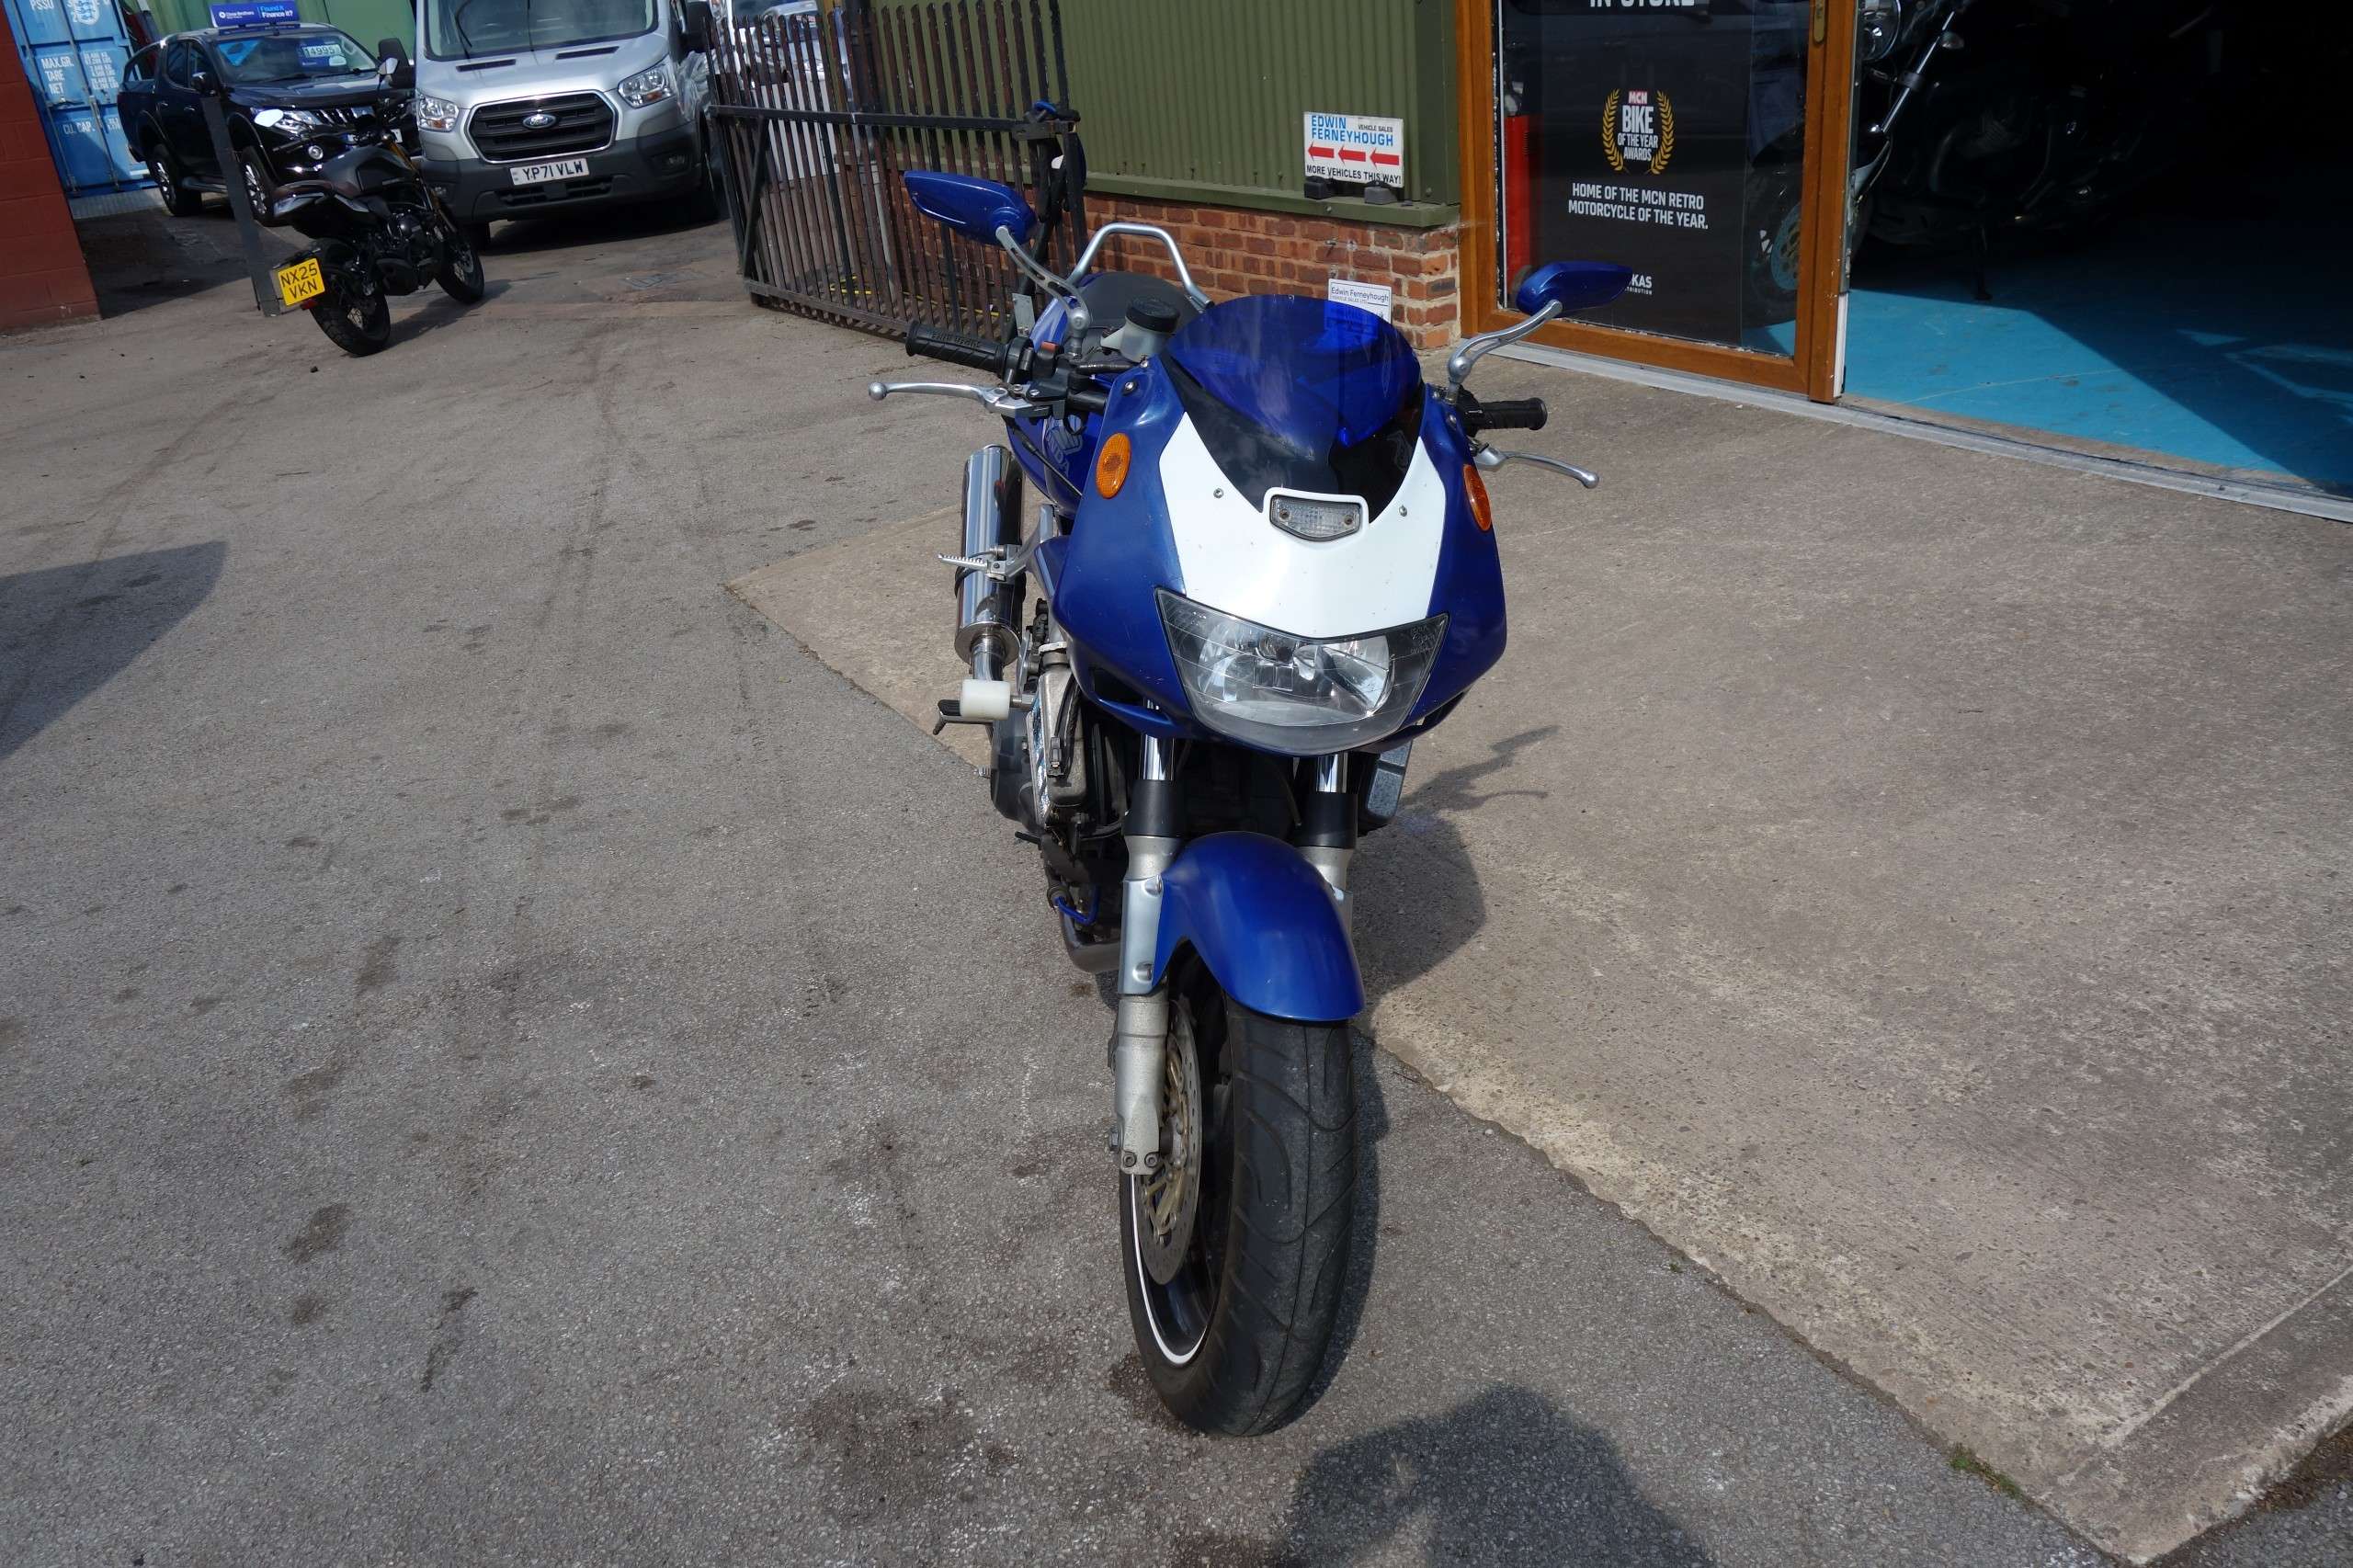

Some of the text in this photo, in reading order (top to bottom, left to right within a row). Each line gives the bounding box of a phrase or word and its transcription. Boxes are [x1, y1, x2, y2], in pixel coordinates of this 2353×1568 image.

[44, 70, 64, 82] TARE
[1629, 91, 1648, 105] MCN
[1312, 115, 1347, 129] EDWIN
[1622, 105, 1654, 134] BIKE
[1312, 128, 1393, 146] FERNEYHOUGH
[1618, 132, 1658, 148] OF THE YEAR
[1623, 147, 1653, 162] AWARDS
[556, 160, 584, 176] VLW
[1306, 165, 1402, 185] MORE VEHICLES THIS WAY!
[1572, 182, 1704, 210] HOME OF THE MCN RETRO
[1568, 199, 1709, 230] MOTORCYCLE OF THE YEAR.
[280, 262, 318, 288] NX25
[289, 278, 318, 299] VKN
[1331, 287, 1389, 303] Edwin Ferneyhough
